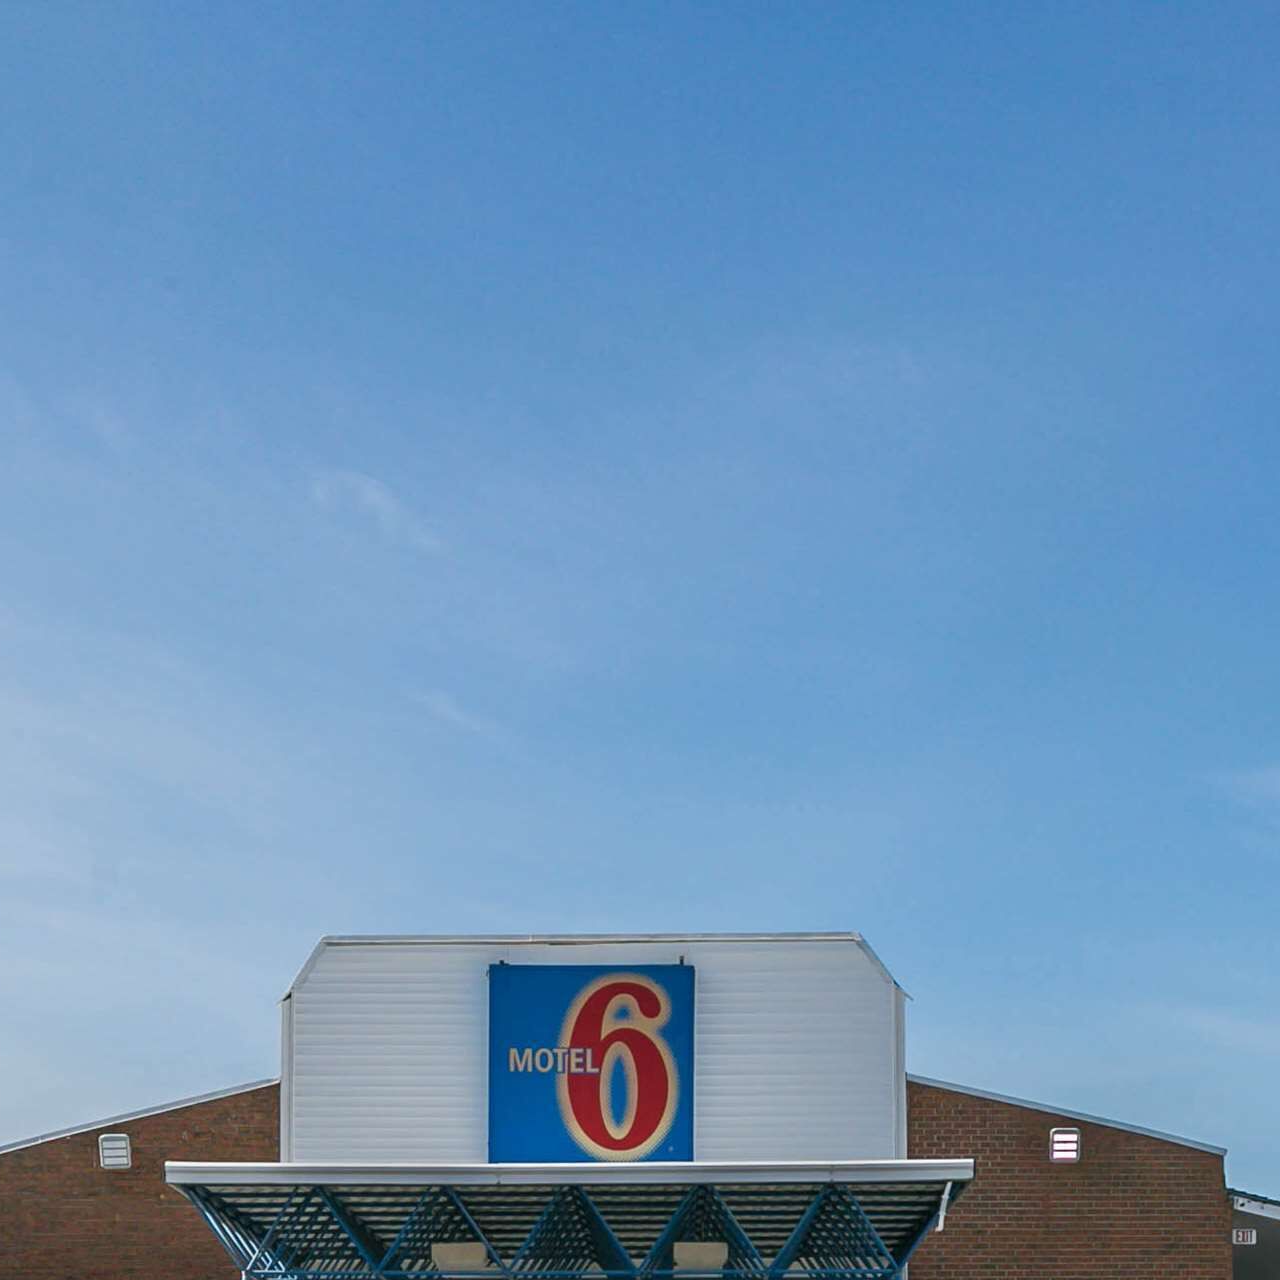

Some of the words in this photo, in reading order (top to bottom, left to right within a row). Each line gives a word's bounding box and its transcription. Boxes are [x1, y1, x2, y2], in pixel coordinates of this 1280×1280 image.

[509, 1047, 600, 1073] MOTEL
[565, 980, 670, 1153] 6
[1235, 1230, 1253, 1243] EXIT
